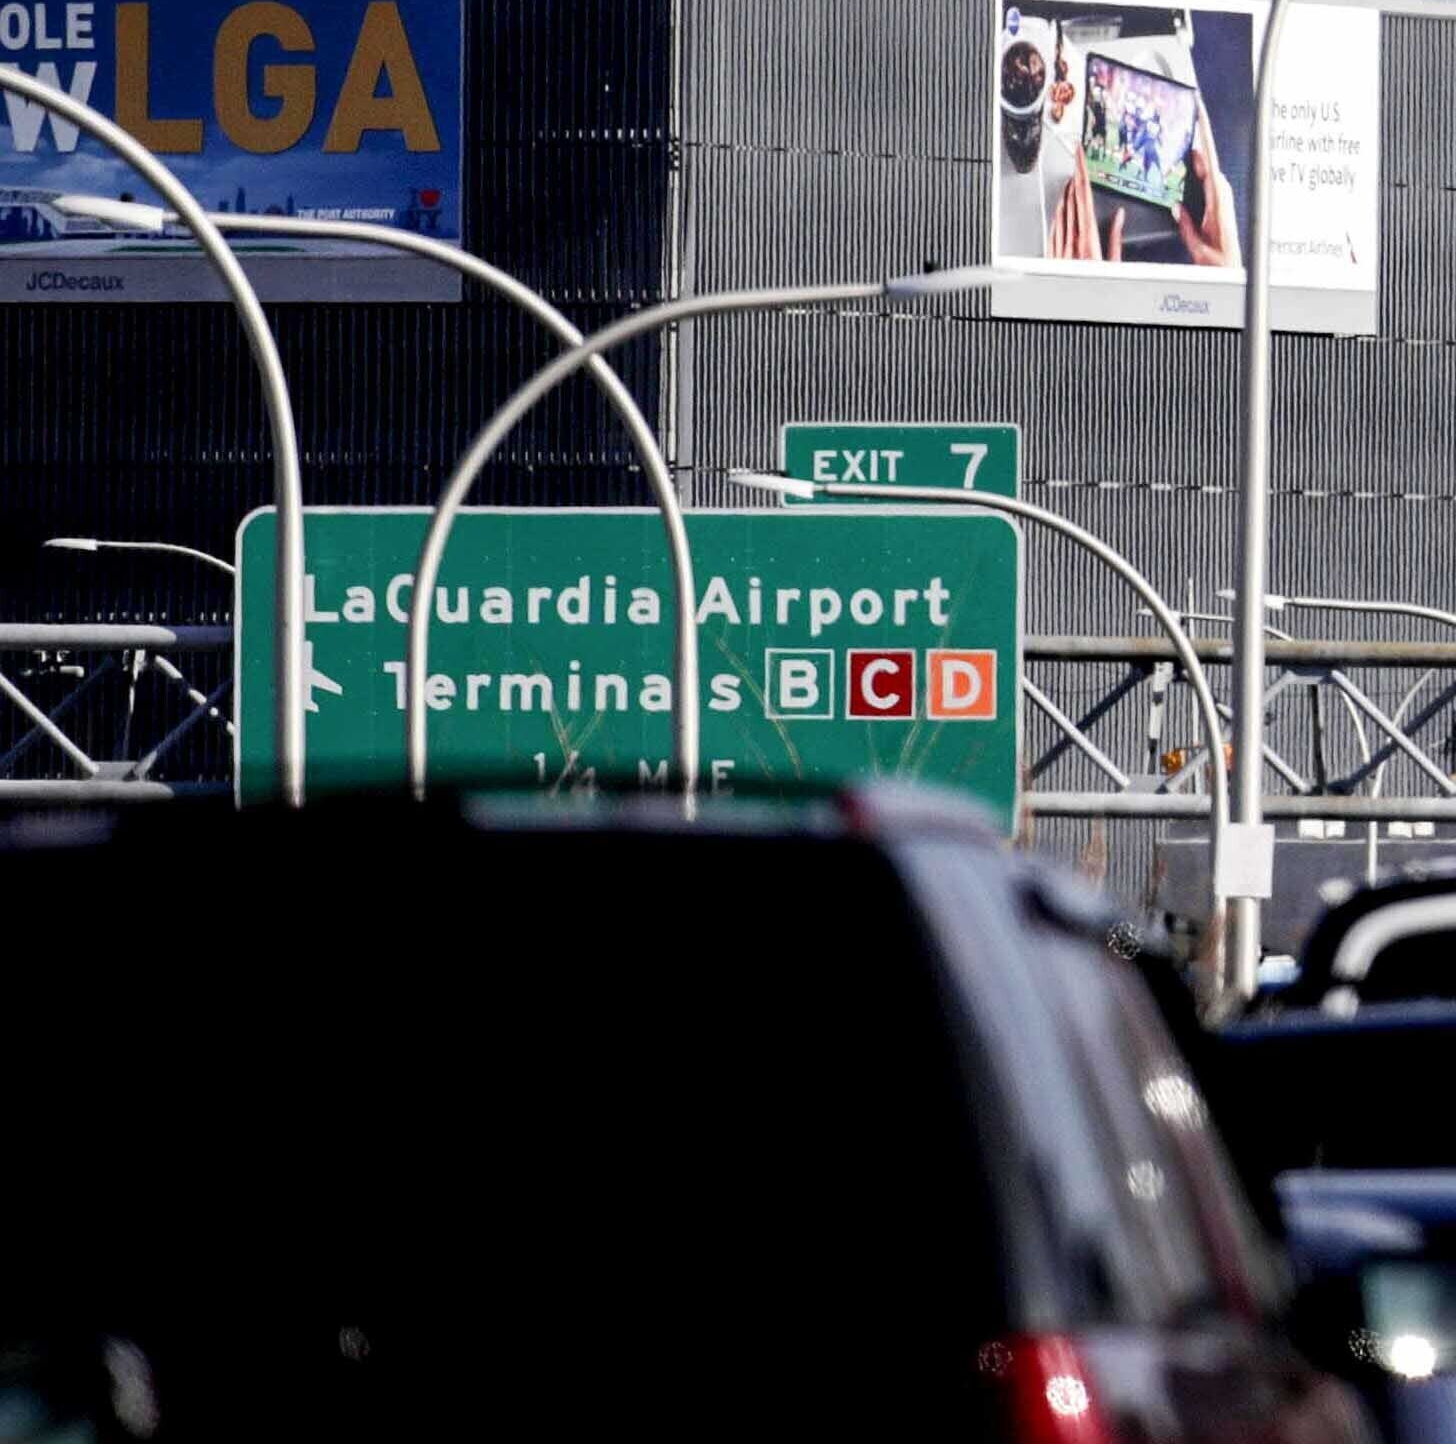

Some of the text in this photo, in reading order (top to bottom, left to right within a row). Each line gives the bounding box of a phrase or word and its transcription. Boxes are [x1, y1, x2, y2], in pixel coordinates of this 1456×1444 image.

[114, 0, 441, 154] LGA
[1271, 99, 1287, 120] he
[1291, 102, 1316, 126] only
[1308, 135, 1334, 154] with
[1338, 133, 1361, 155] free
[1290, 162, 1306, 184] TV
[1308, 165, 1355, 193] globally
[26, 271, 125, 292] JCDecaux
[812, 443, 989, 491] EXIT 7
[695, 576, 950, 636] Airport
[383, 658, 983, 711] Terminas B C D
